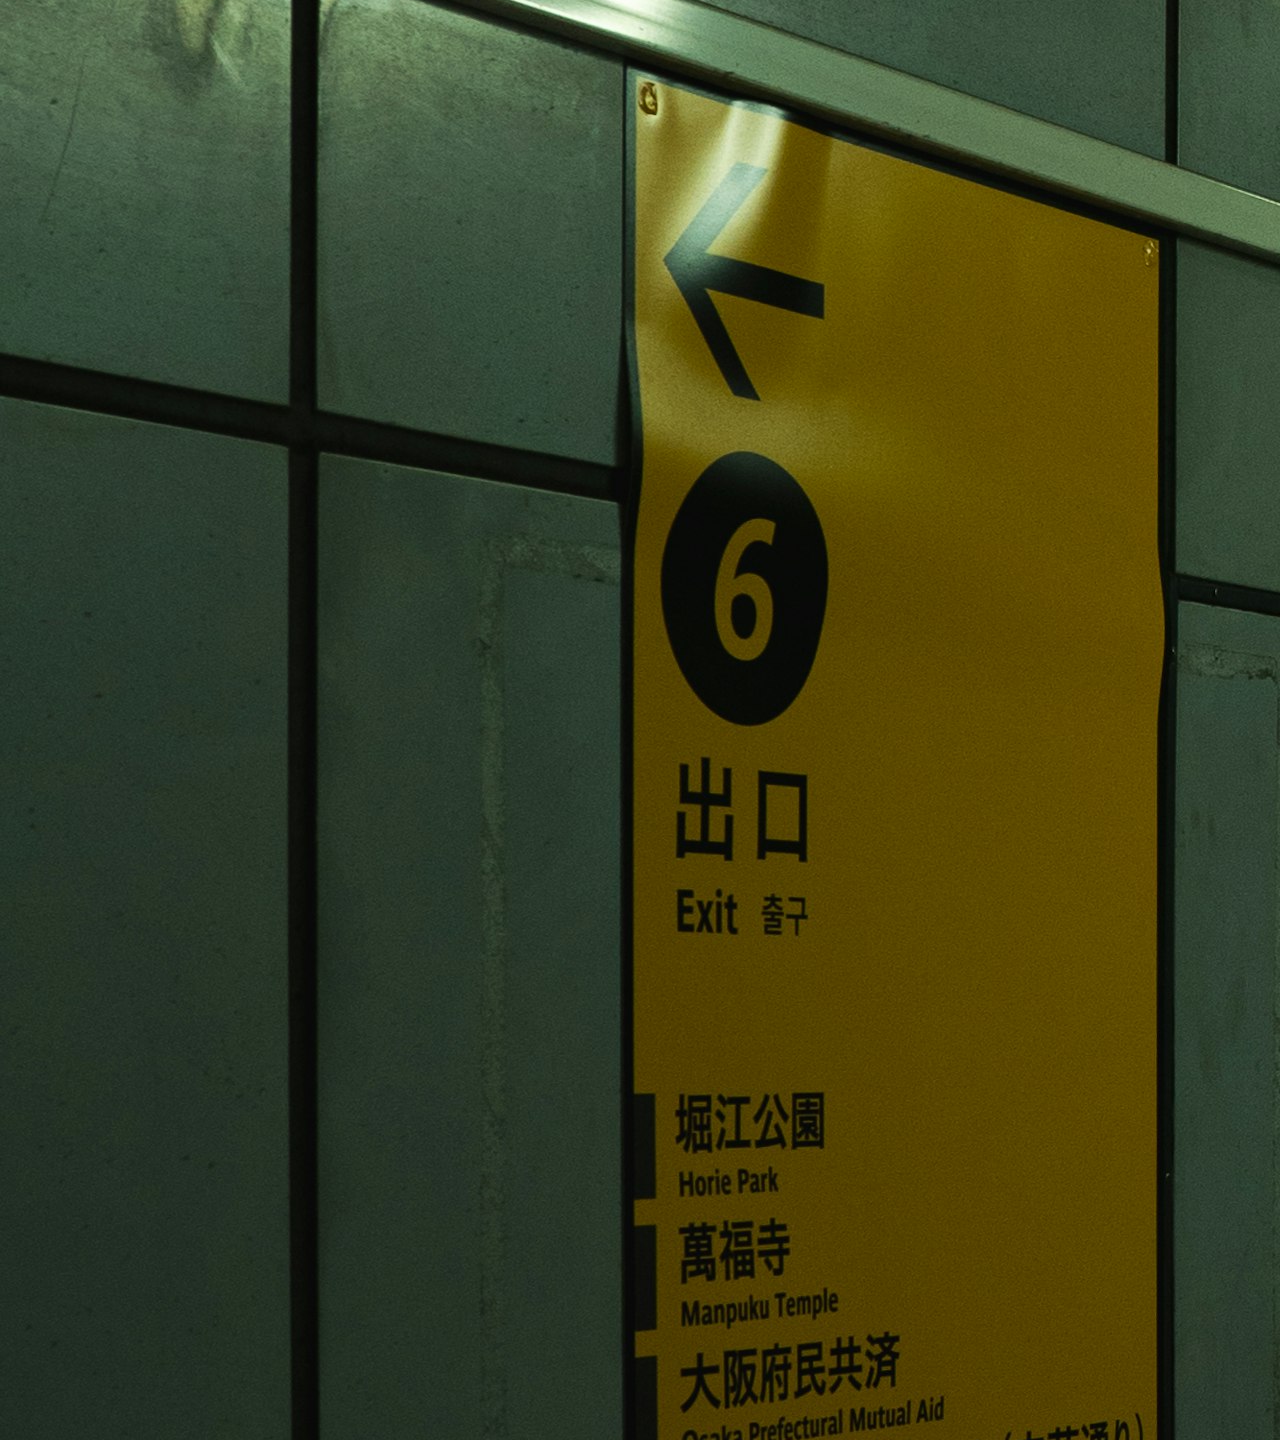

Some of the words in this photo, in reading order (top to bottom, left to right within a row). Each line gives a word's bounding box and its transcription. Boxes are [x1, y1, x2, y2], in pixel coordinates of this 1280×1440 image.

[715, 518, 775, 660] 6
[676, 757, 807, 862] 出口
[677, 889, 737, 934] Exit
[762, 894, 808, 935] 출구
[675, 1092, 824, 1153] 堀江公園
[679, 1169, 731, 1196] Horie
[738, 1166, 778, 1193] Park
[679, 1218, 789, 1284] 萬福寺
[682, 1296, 769, 1328] Manpuku
[775, 1288, 838, 1319] Temple
[680, 1332, 899, 1412] 大阪府民共済
[850, 1401, 911, 1431] Mutual
[917, 1397, 944, 1422] Aid
